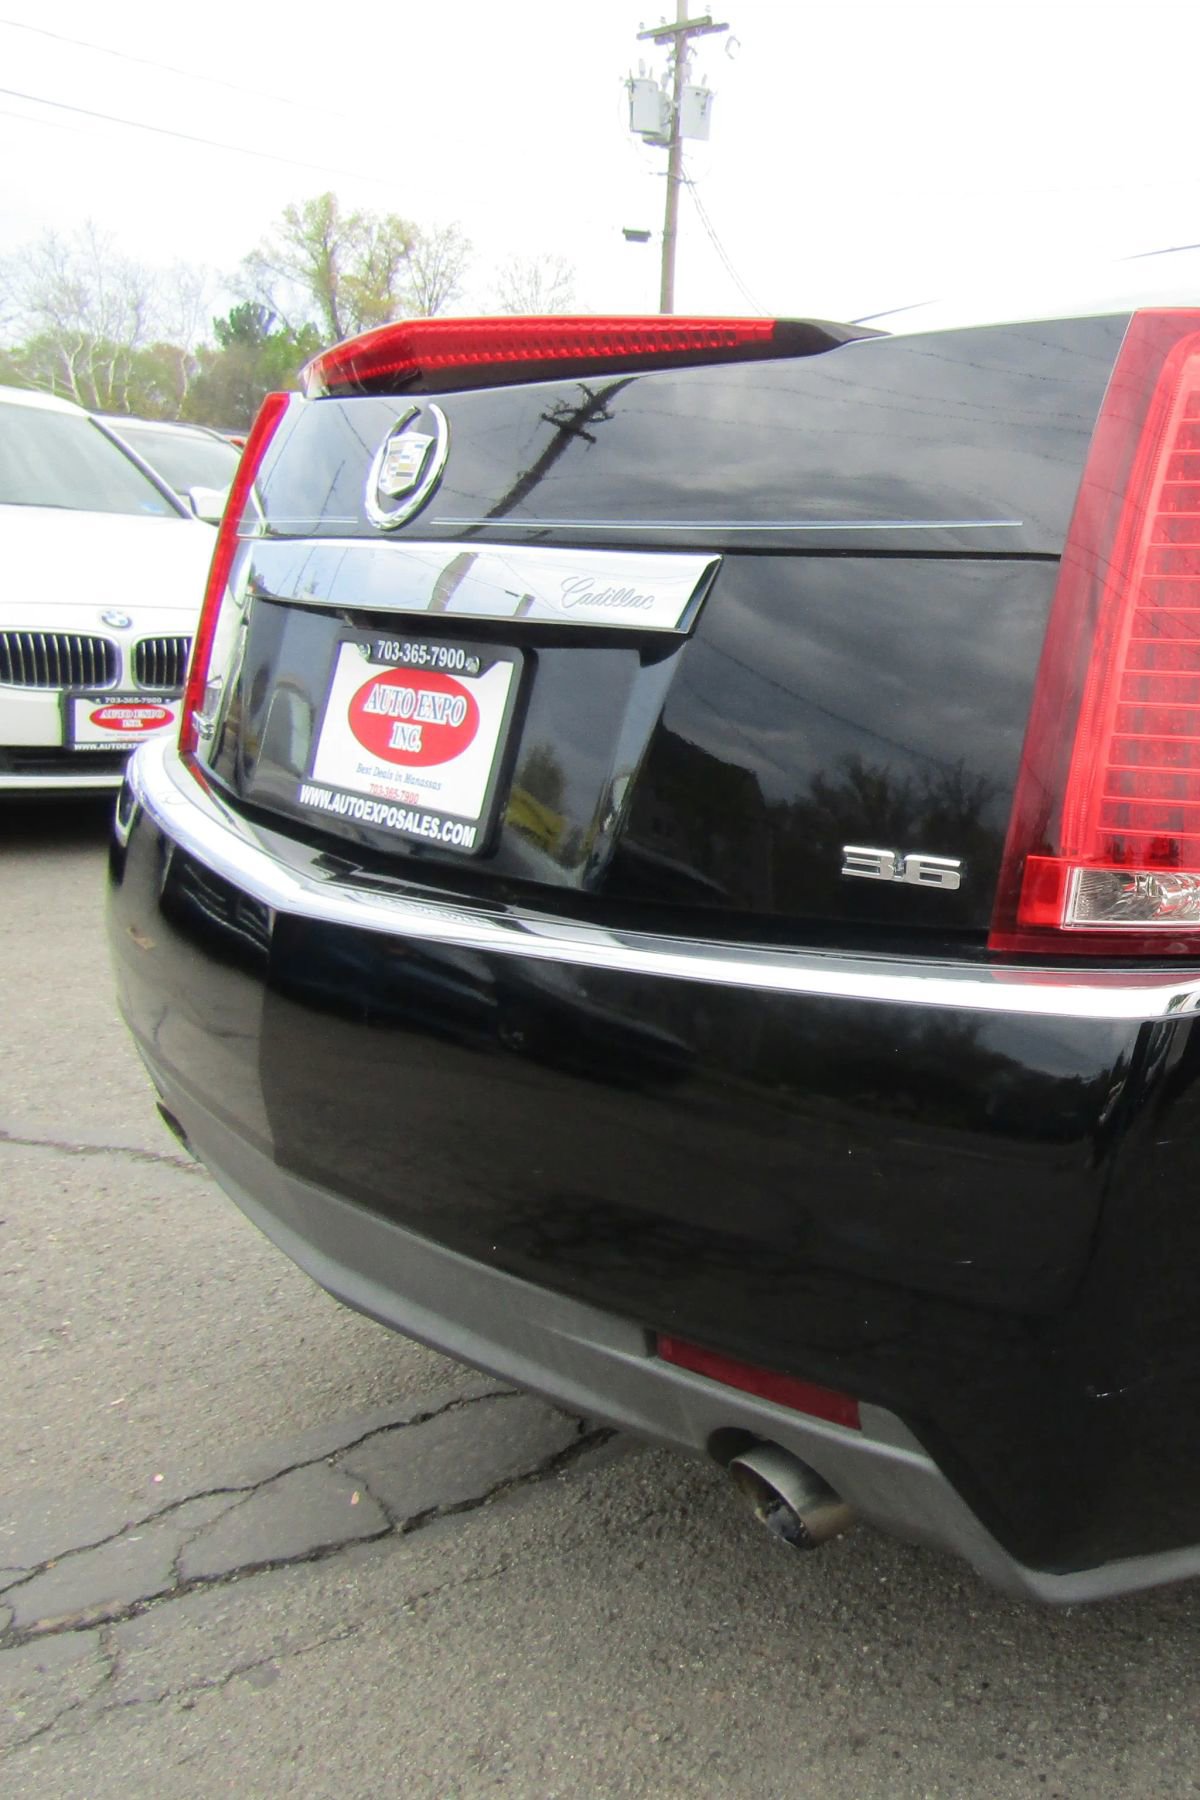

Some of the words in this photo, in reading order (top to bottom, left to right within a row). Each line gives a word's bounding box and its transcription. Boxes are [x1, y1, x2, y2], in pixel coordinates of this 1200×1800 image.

[560, 576, 656, 610] Cadillac
[378, 641, 466, 669] 703-365-7900
[364, 684, 414, 719] AUTO
[414, 691, 467, 727] EXPO
[389, 723, 422, 752] INC.
[373, 766, 393, 780] Deals
[299, 785, 477, 848] WWW.AUTOEXPOSALES.COM
[842, 845, 961, 890] 3.6
